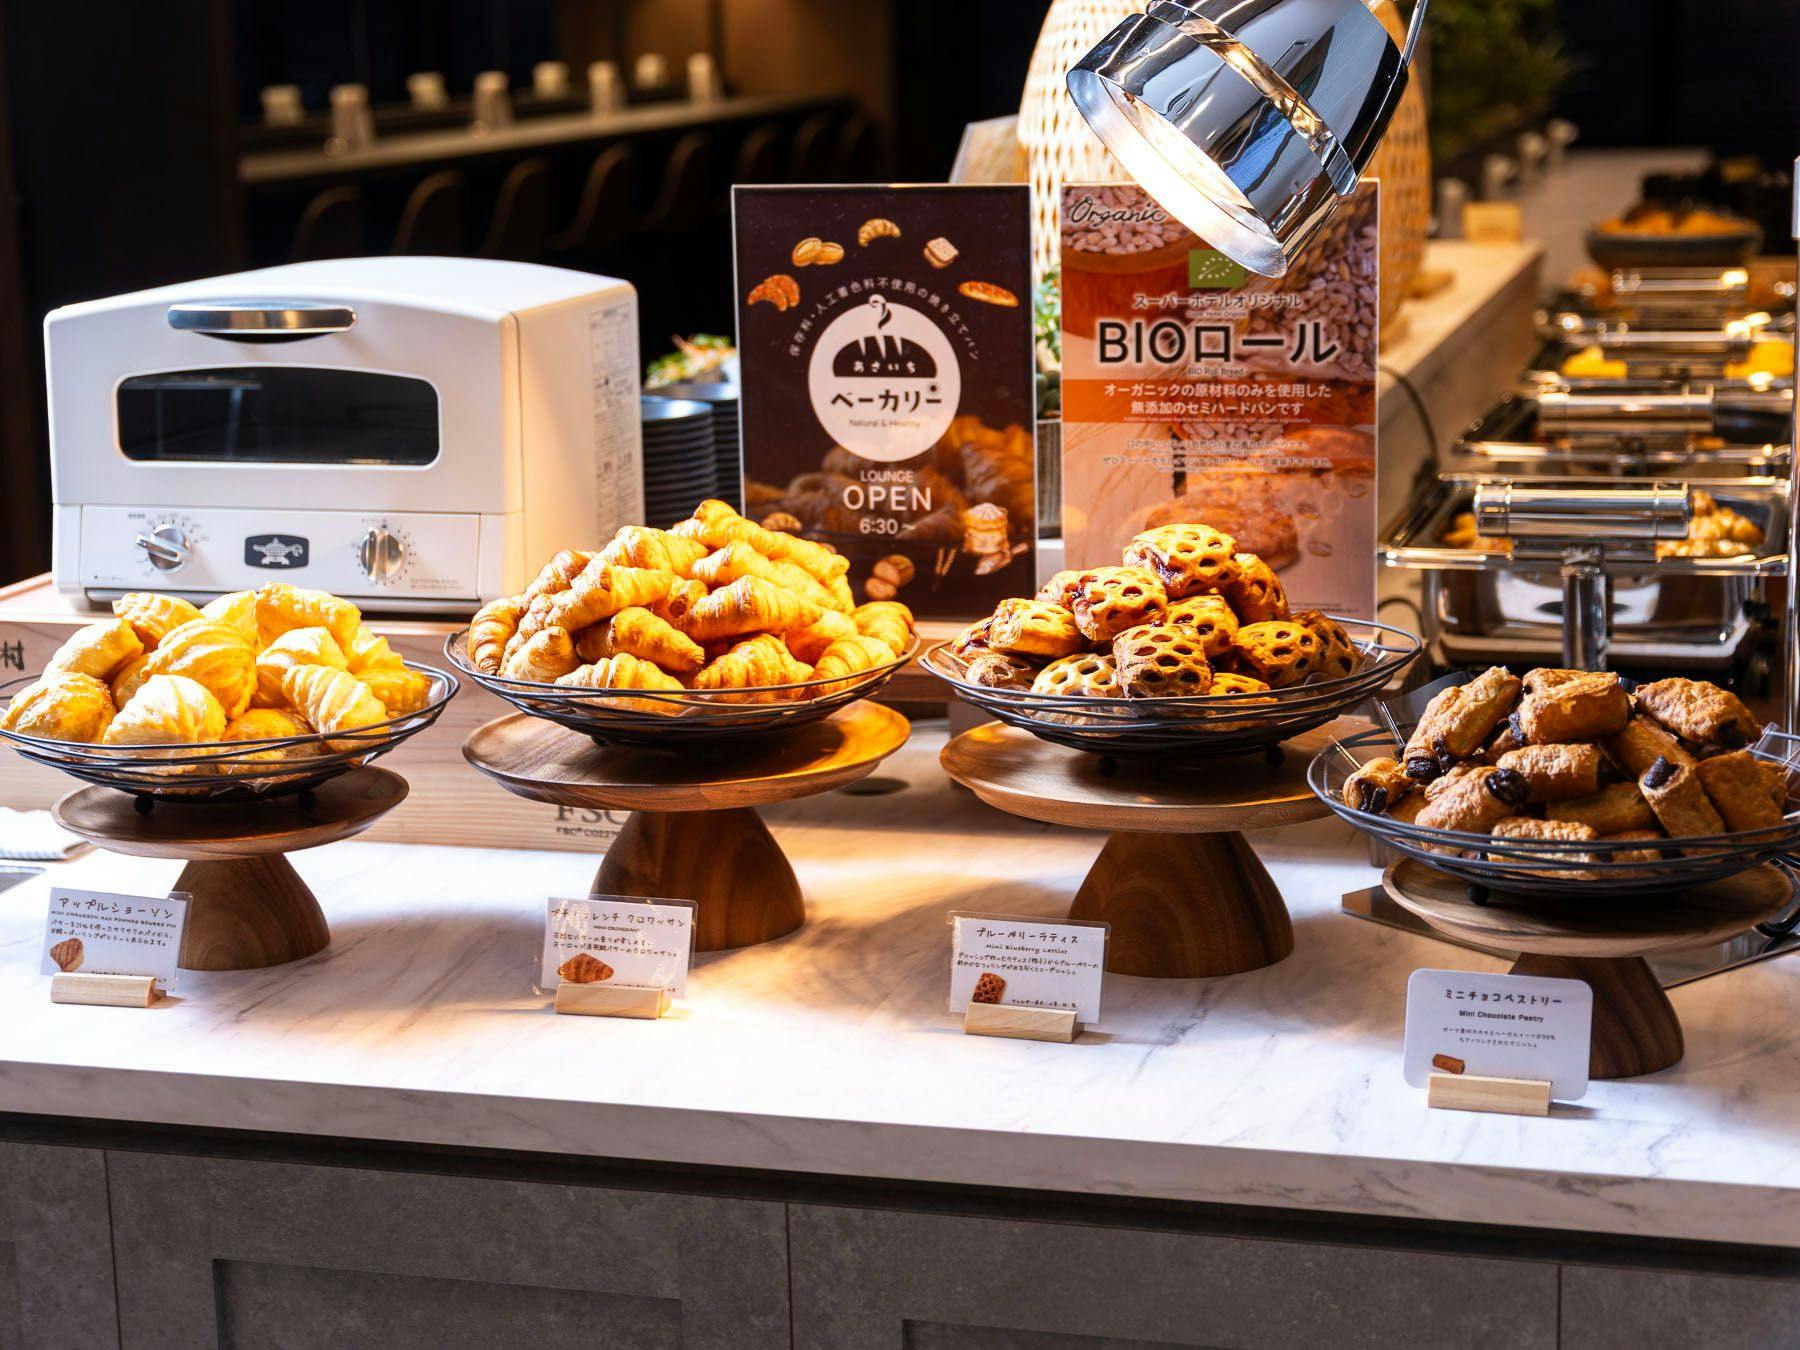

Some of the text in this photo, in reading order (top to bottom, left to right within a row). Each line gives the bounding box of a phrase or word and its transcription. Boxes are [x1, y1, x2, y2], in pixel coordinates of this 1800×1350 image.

[1071, 196, 1167, 227] Organic
[1133, 293, 1302, 309] スーパーホテルオリジナル
[1099, 321, 1338, 364] BIOロール
[853, 360, 917, 374] あさいち
[1104, 383, 1332, 398] オーガニックの原材料のみを使用した
[831, 388, 943, 413] ベーカリー
[1131, 400, 1305, 416] 無添加のセミハードパンです
[849, 418, 879, 428] Natural
[861, 469, 914, 483] LOUNGE
[842, 486, 932, 512] OPEN
[59, 897, 175, 919] アップルショーソン
[627, 913, 686, 928] クロワッサン
[976, 927, 1079, 944] ブルーベリーラティス
[986, 943, 1003, 951] Mini
[1445, 988, 1563, 1006] ミニチョコペストリー
[1459, 1009, 1545, 1024] Mini Chocolate Pastry
